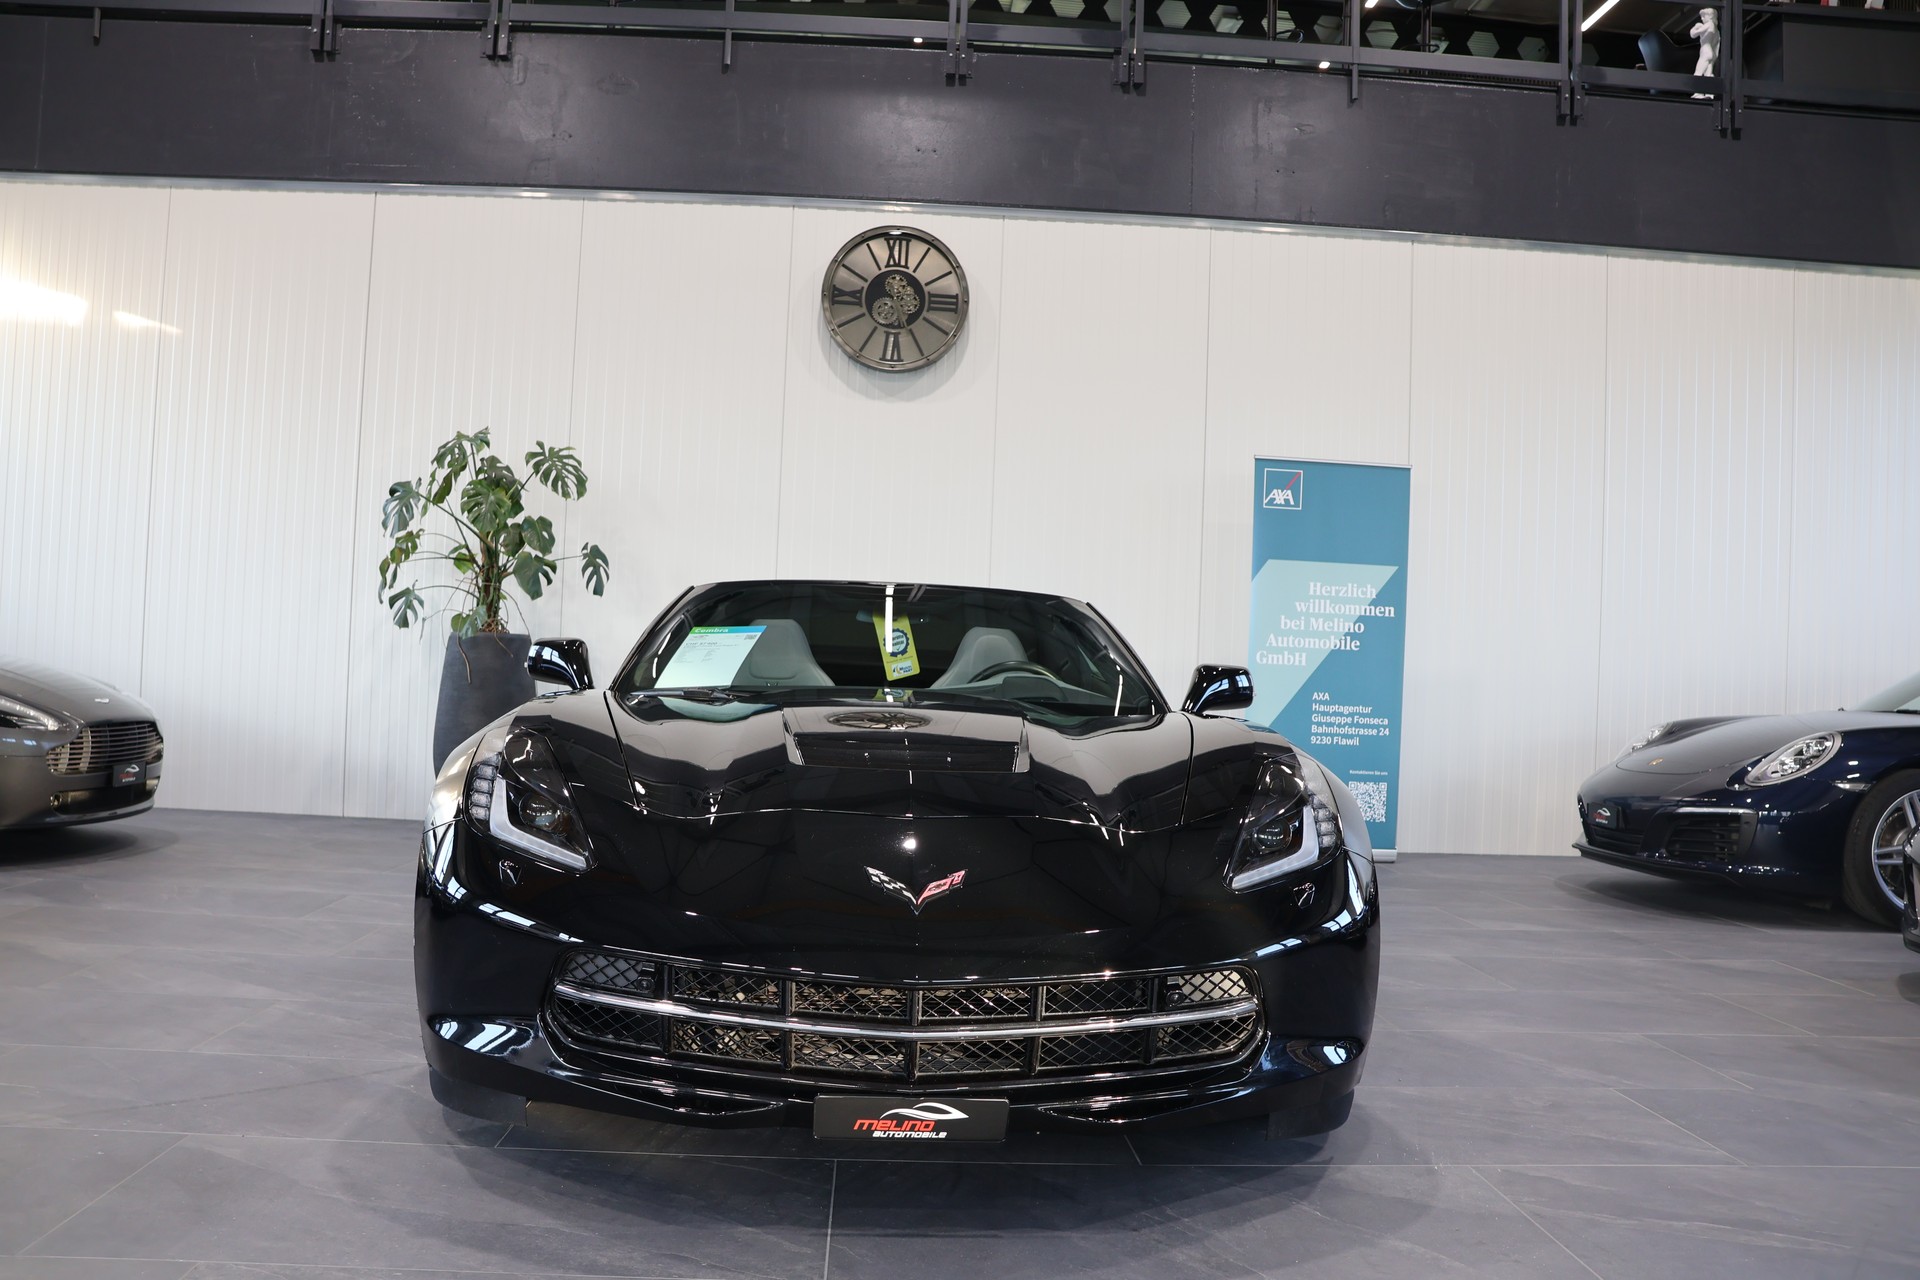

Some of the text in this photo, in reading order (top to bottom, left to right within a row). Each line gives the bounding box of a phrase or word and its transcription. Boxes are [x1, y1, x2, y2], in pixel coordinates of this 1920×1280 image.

[884, 238, 912, 270] XII
[927, 291, 959, 315] III
[1264, 488, 1295, 505] AXA
[1308, 582, 1377, 599] Herzlich
[1295, 599, 1396, 618] willkommen
[1280, 615, 1365, 634] bei Melino
[1266, 633, 1360, 651] Automobile
[1255, 650, 1307, 666] GmbH
[1312, 691, 1330, 701] AXA
[1312, 702, 1373, 715] Hauptagentur
[1311, 713, 1389, 725] Giuseppe Fonseca
[1311, 724, 1390, 736] Bahnhofstrasse 24
[1310, 735, 1360, 746] 9230 Flawil
